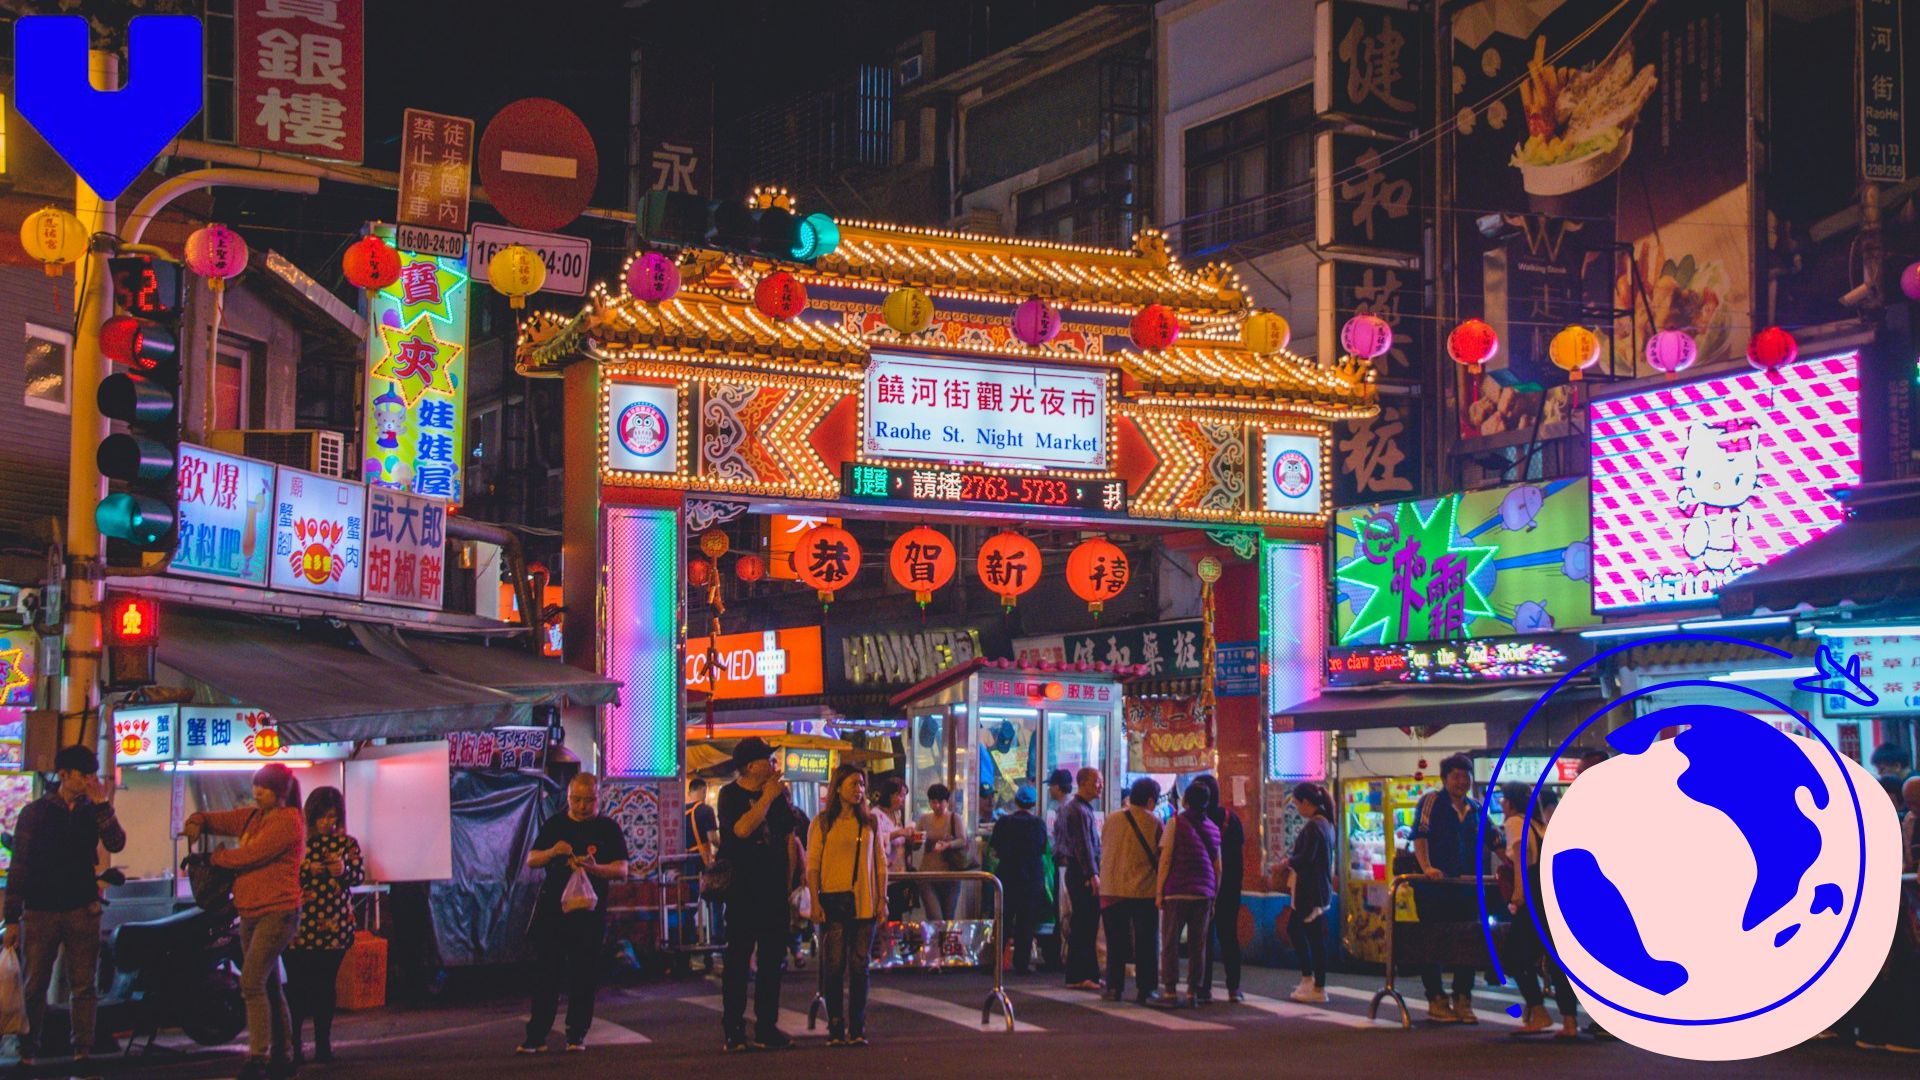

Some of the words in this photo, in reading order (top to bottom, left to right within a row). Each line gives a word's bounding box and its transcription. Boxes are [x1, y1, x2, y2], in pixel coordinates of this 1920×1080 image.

[1870, 0, 1894, 101] 河街
[1866, 106, 1899, 121] RaoHe
[408, 117, 435, 219] 禁止停車
[439, 121, 465, 223] 徒步區內
[400, 229, 461, 254] 16:00-24:00
[876, 373, 1097, 419] 饒河街觀光夜市
[415, 399, 455, 498] 娃娃屋
[875, 420, 932, 442] Raohe
[942, 425, 965, 443] St.
[976, 427, 1024, 450] Night
[1035, 431, 1098, 452] Market
[369, 498, 443, 550] 武大郎
[368, 545, 441, 601] 胡椒餅
[810, 539, 851, 583] 恭
[904, 541, 943, 584] 賀
[984, 550, 1028, 588] 新
[685, 648, 754, 686] COMED
[1346, 653, 1371, 670] claw
[1373, 654, 1405, 672] games
[1437, 647, 1457, 666] the
[1067, 683, 1110, 702] 服務台
